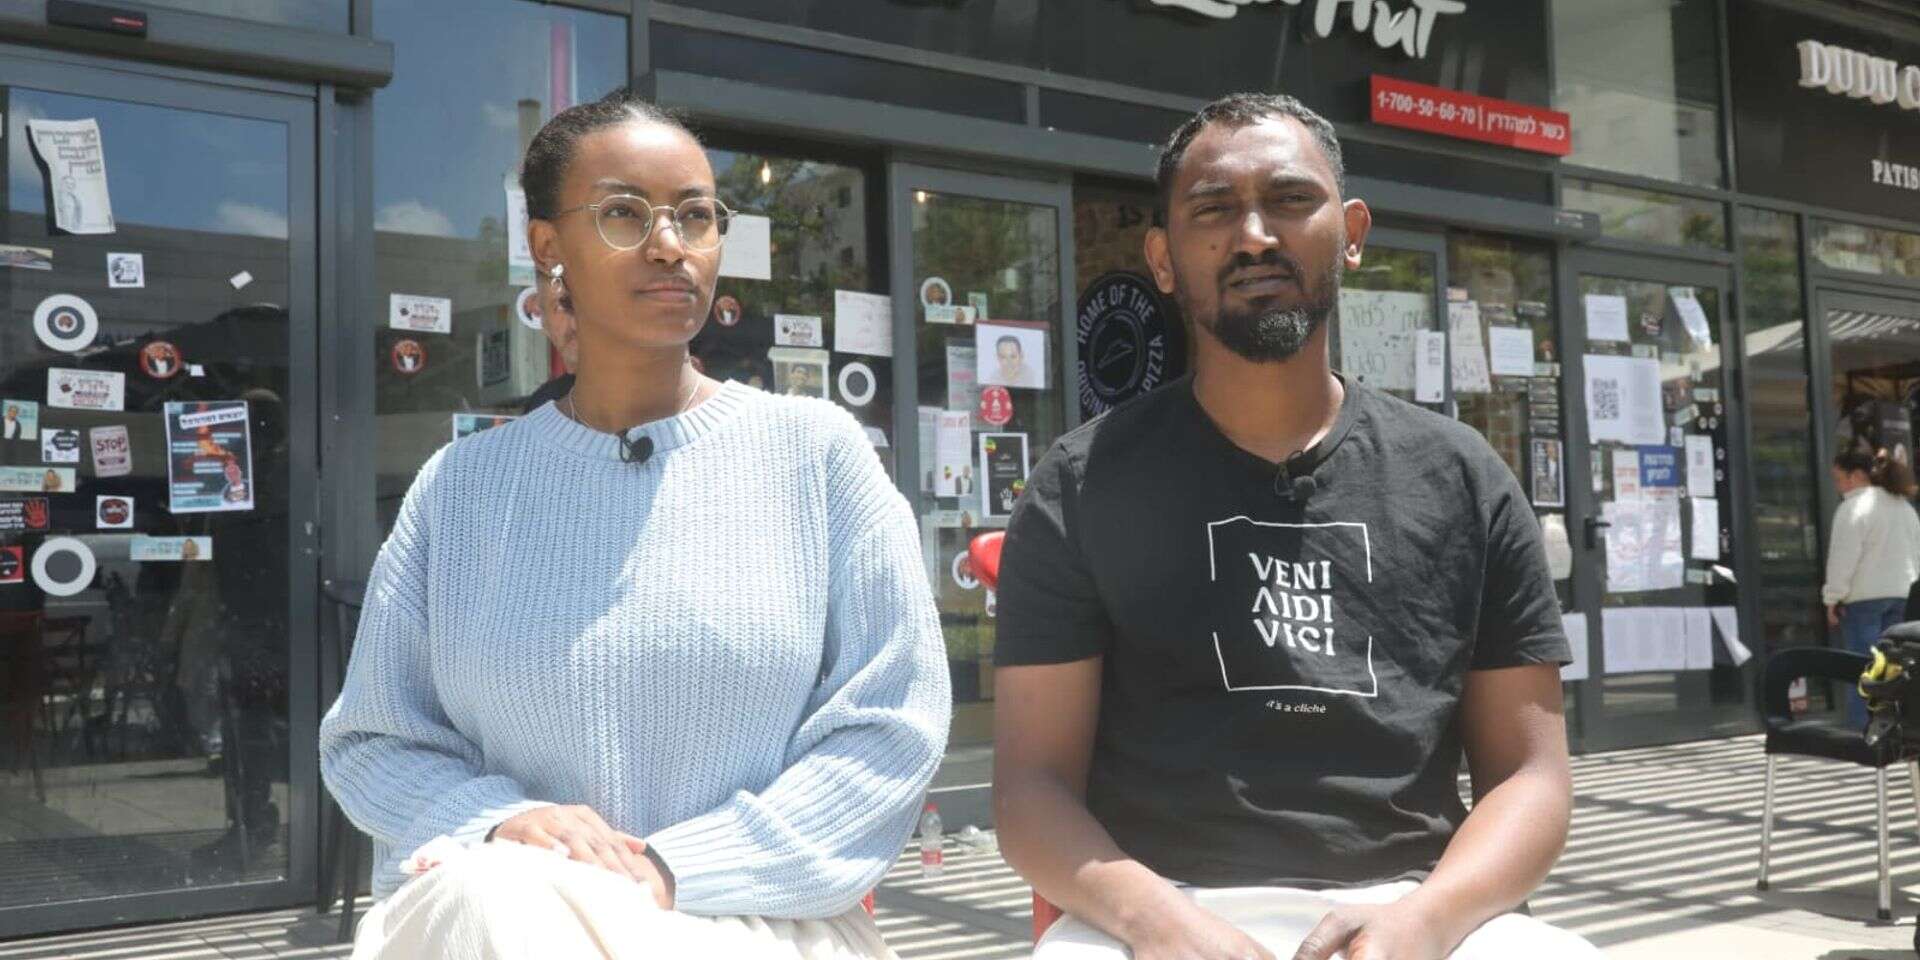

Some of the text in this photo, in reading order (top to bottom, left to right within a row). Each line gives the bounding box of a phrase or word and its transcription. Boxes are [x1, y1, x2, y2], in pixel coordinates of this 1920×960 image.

[1797, 39, 1898, 109] DUDU
[1376, 89, 1565, 141] כשר למהדרין 1-700-50-60-70
[1871, 159, 1920, 190] PATIS
[1076, 284, 1154, 345] HOME OF THE
[1142, 333, 1164, 392] PIZZA
[1248, 552, 1332, 590] VENI
[1254, 618, 1336, 656] VICI
[1284, 704, 1292, 712] a
